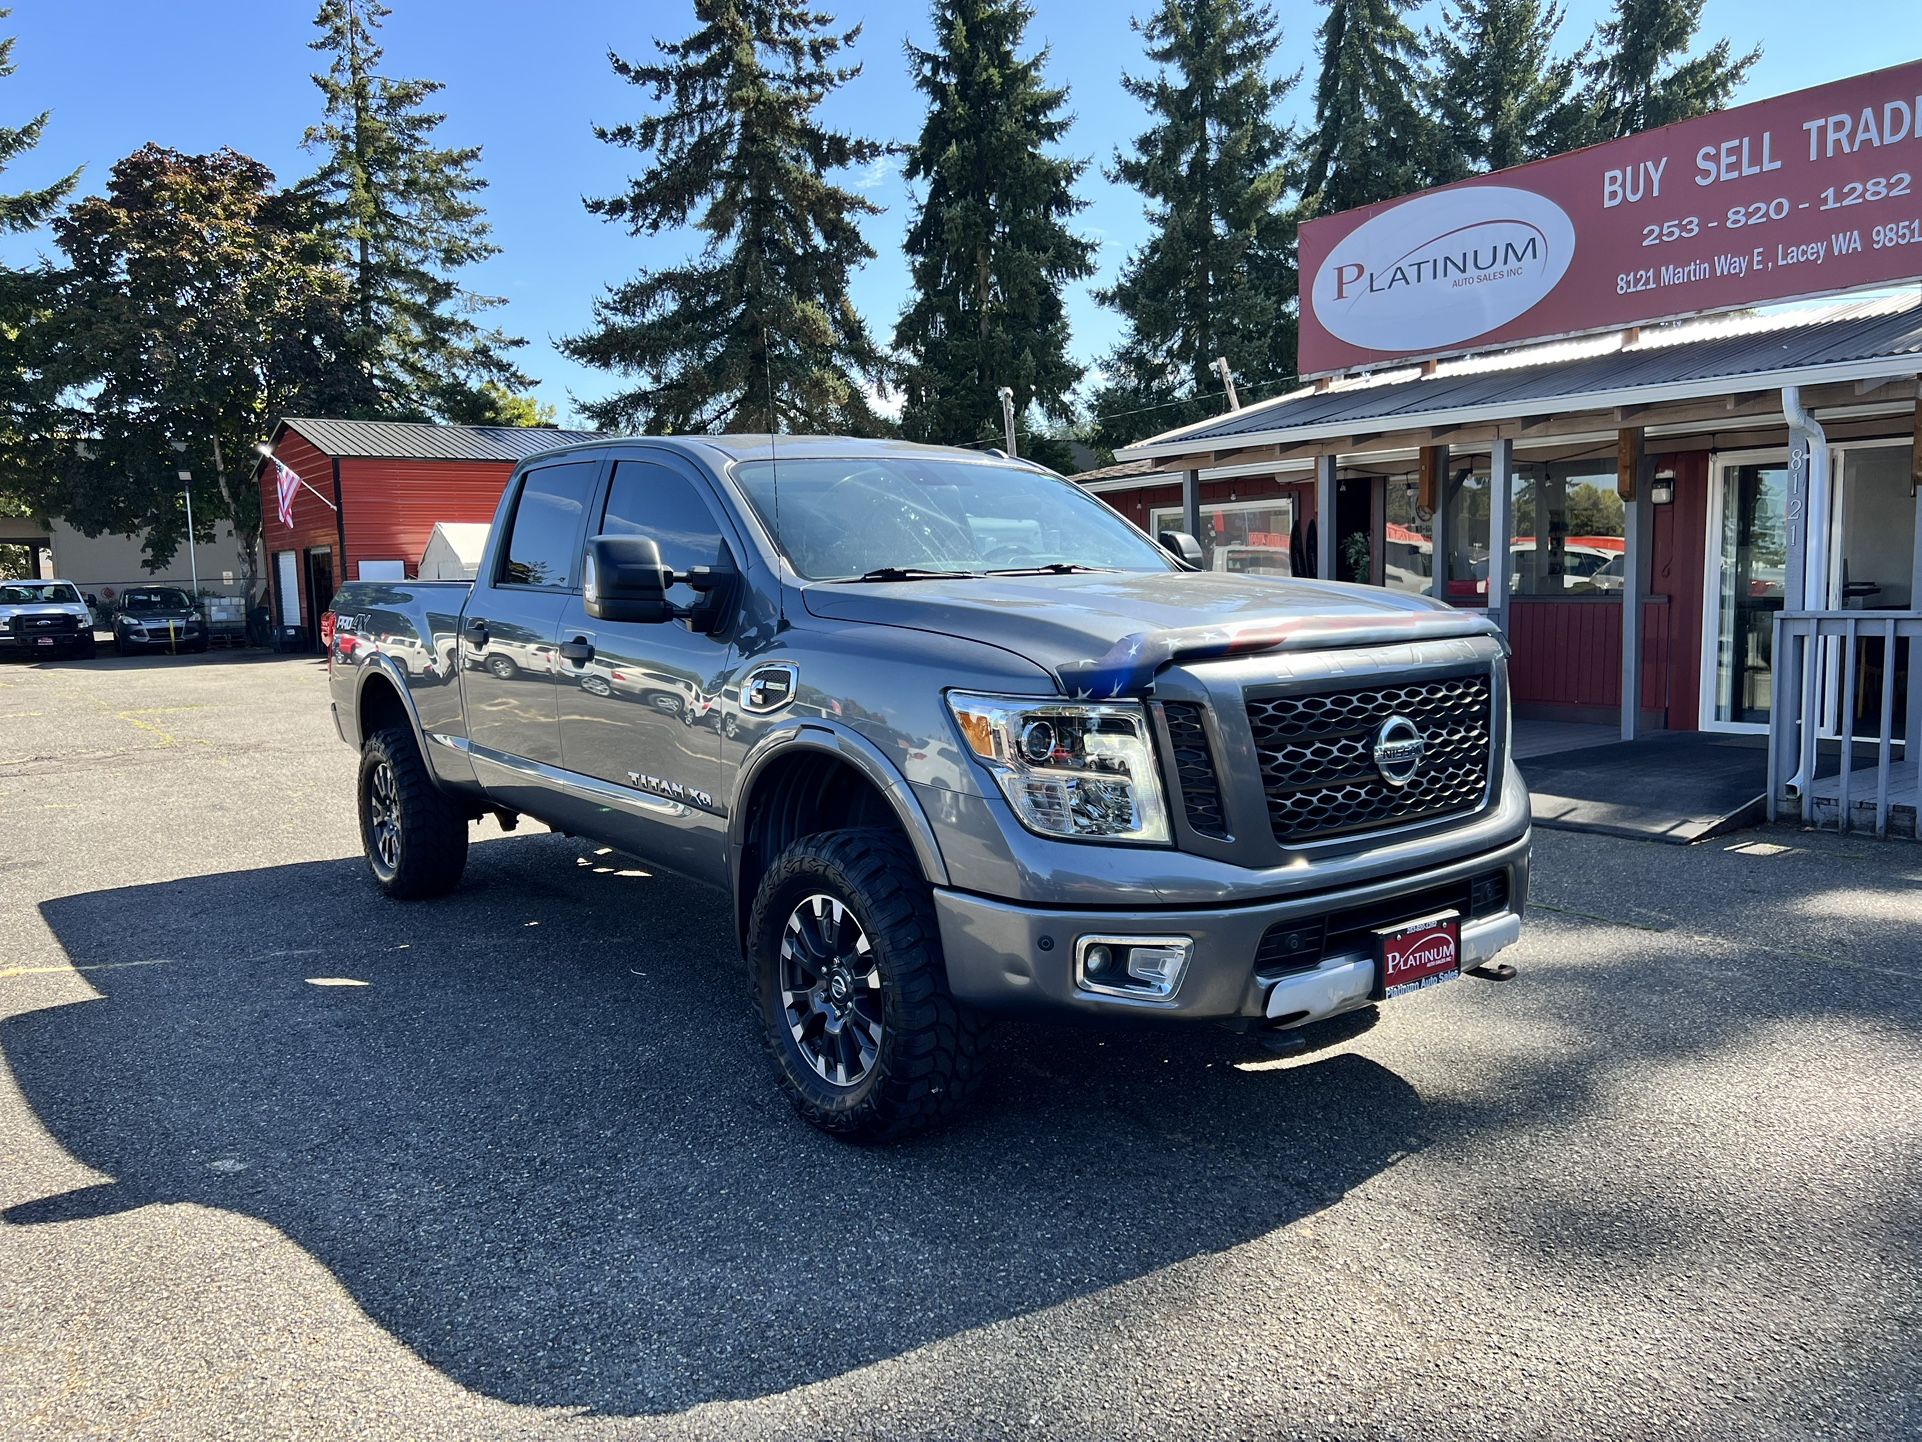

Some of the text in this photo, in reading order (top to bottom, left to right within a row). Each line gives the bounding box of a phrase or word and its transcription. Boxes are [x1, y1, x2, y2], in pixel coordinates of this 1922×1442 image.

[1603, 156, 1668, 209] BUY
[1694, 130, 1782, 187] SELL
[1641, 216, 1700, 247] 253
[1726, 198, 1790, 229] 820
[1819, 172, 1912, 211] 1282
[1332, 236, 1538, 302] PLATINUM
[1451, 266, 1523, 289] AUTO SALES INC
[1616, 267, 1657, 295] 8121
[1660, 259, 1710, 287] Martin
[1714, 253, 1749, 278] Way
[1753, 247, 1764, 270] E
[1777, 241, 1827, 265] Lacey
[1831, 230, 1862, 257] WA
[627, 771, 713, 807] TITAN XD
[1386, 943, 1455, 975] PLATINUM
[1385, 970, 1459, 999] Platinum Auto Sales
